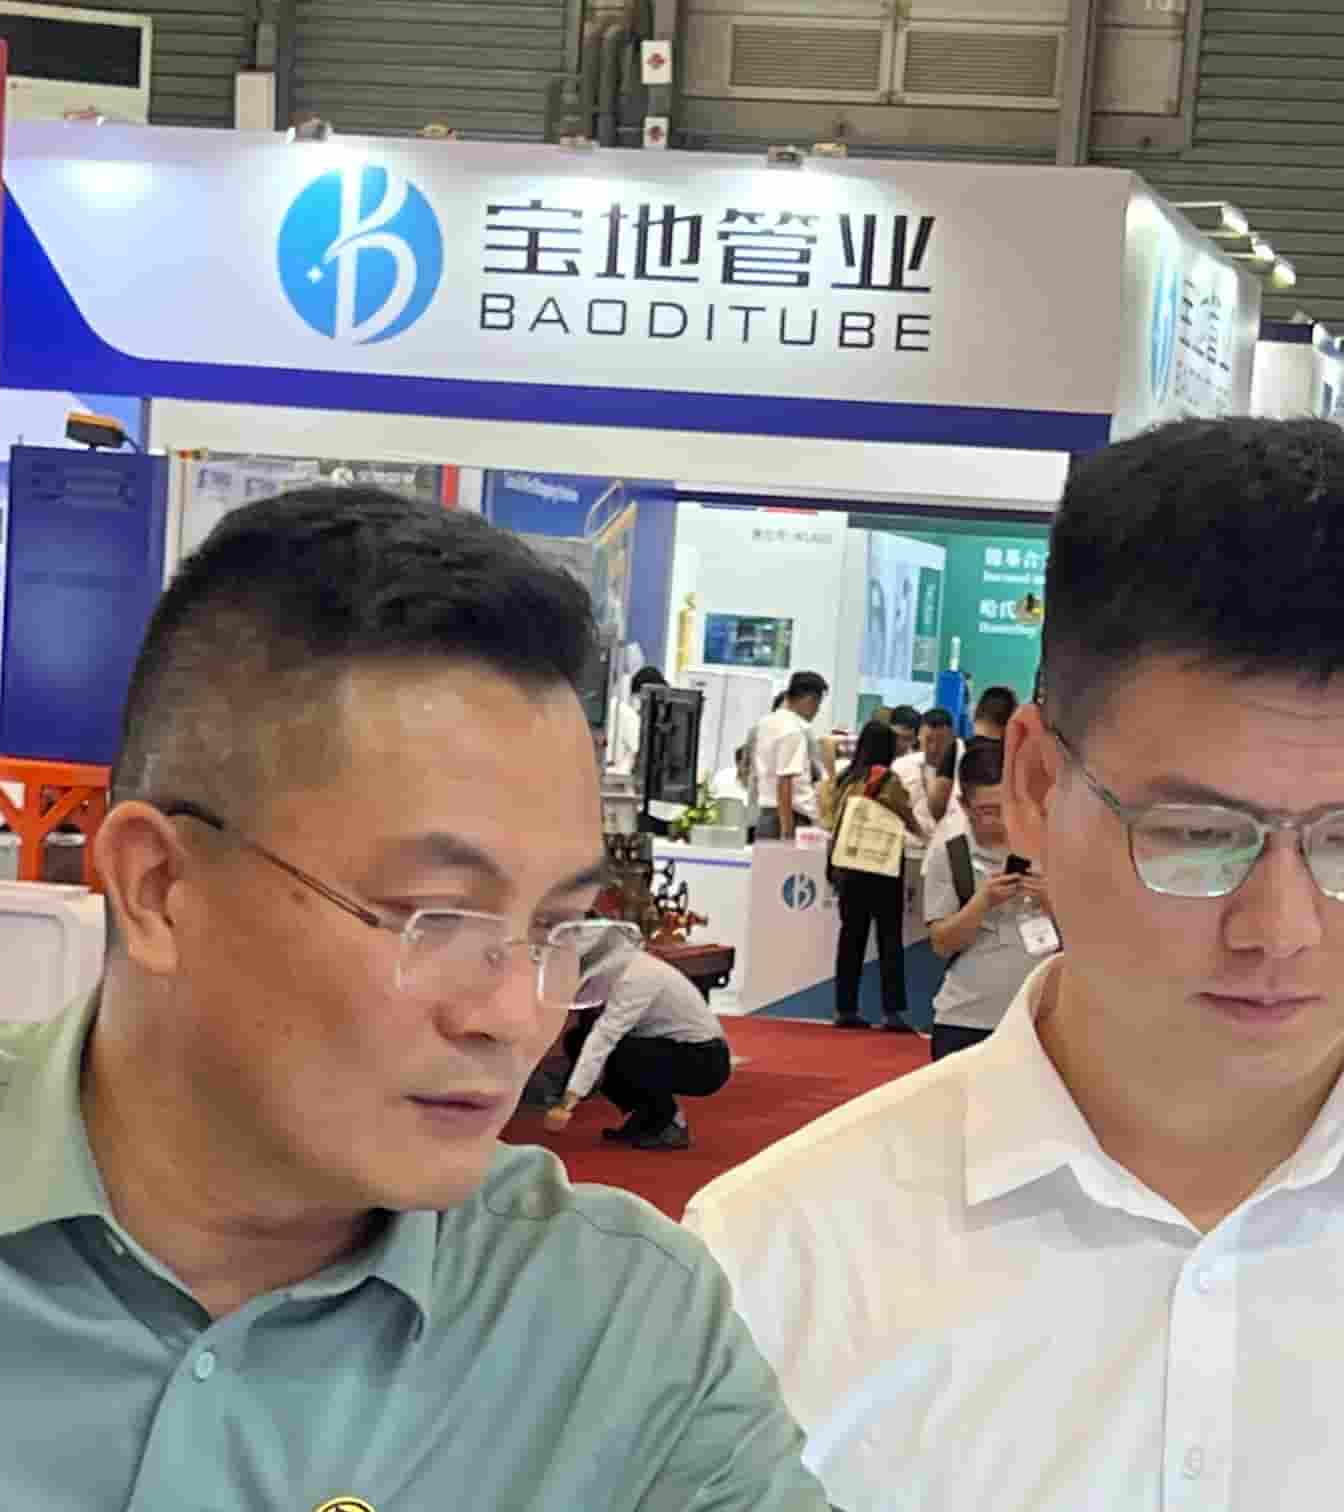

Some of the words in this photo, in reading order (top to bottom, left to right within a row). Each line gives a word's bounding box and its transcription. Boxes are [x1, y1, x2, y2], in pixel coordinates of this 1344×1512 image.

[483, 199, 937, 294] 宝地管业
[479, 292, 932, 353] BAODITUBE
